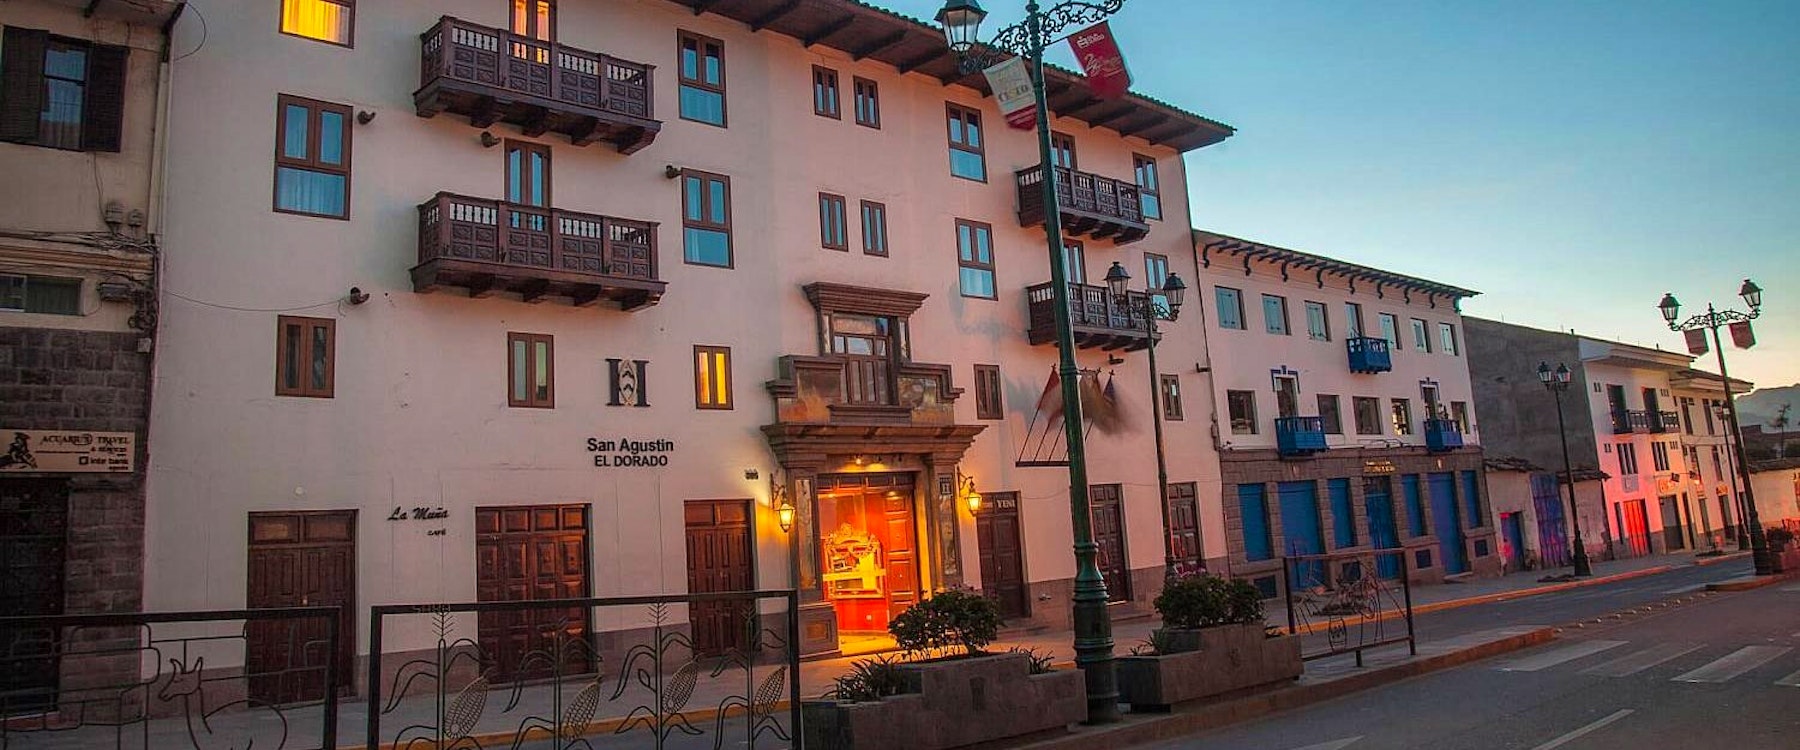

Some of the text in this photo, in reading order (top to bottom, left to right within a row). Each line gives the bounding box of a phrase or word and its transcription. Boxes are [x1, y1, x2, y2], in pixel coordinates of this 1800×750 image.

[587, 437, 674, 455] San Agustin
[594, 455, 668, 467] EL DORADO
[387, 506, 408, 520] La
